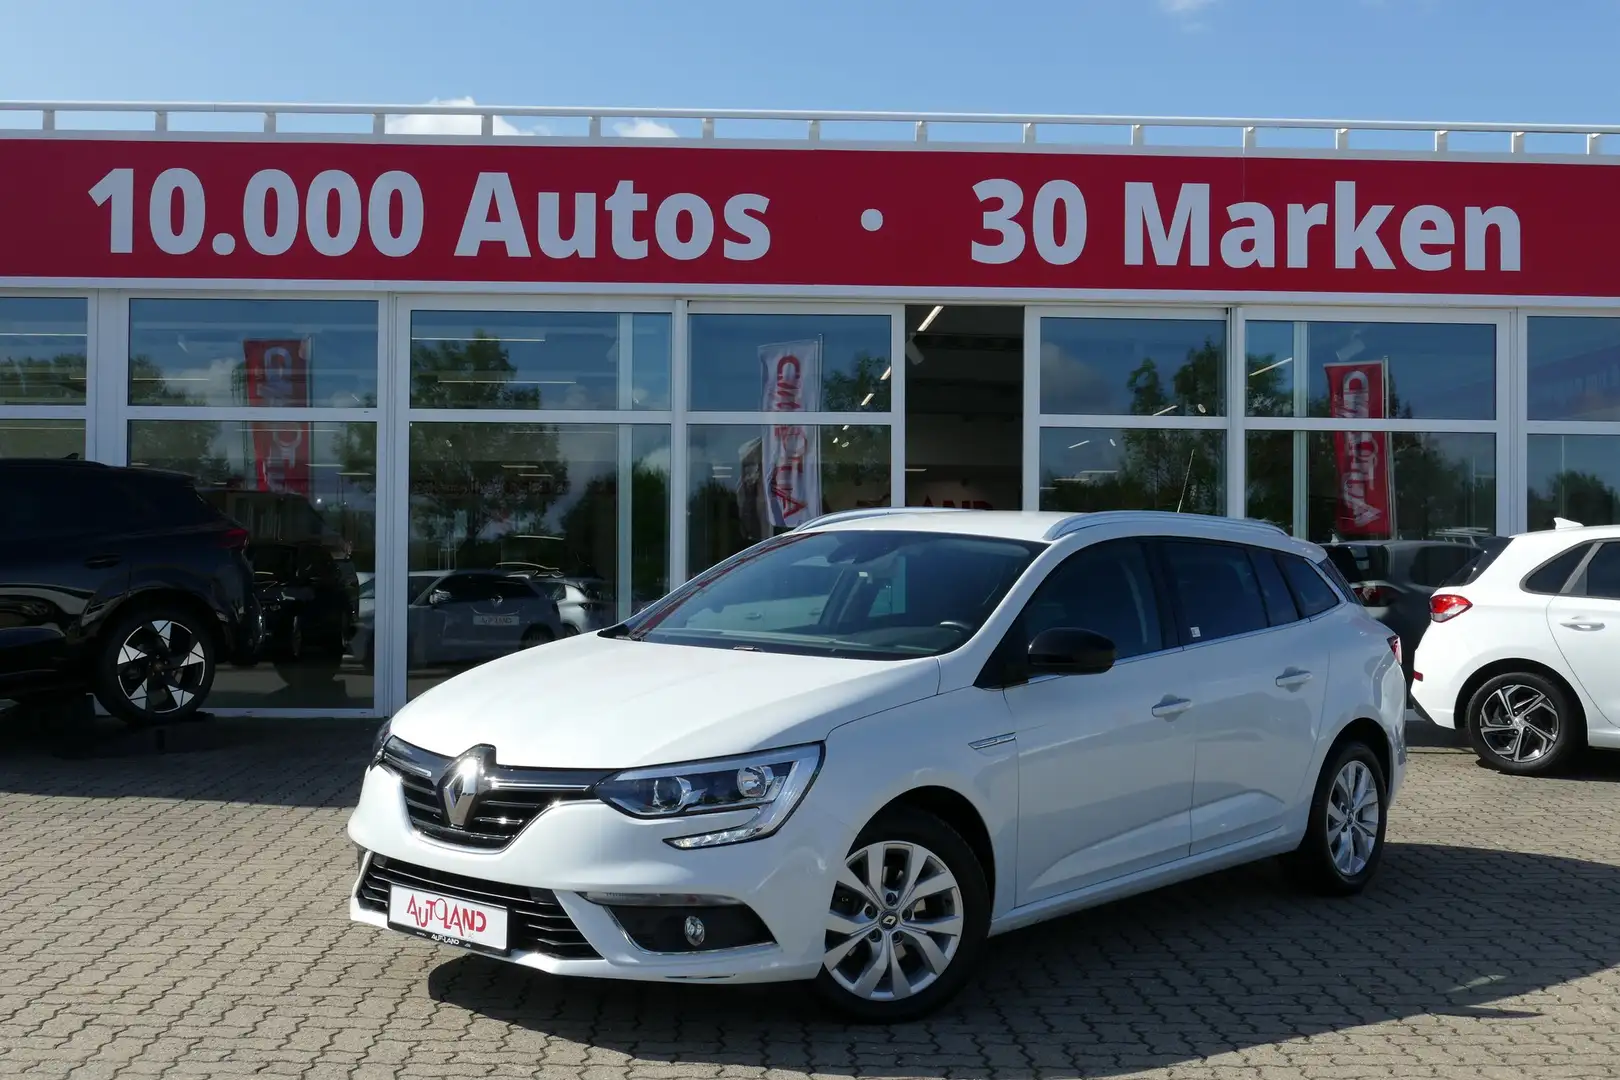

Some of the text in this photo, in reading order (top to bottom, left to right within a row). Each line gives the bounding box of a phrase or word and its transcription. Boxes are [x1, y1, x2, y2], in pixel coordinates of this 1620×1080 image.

[89, 168, 1520, 271] 10.000 Autos 30 Marken
[407, 894, 487, 936] AUTOLAND
